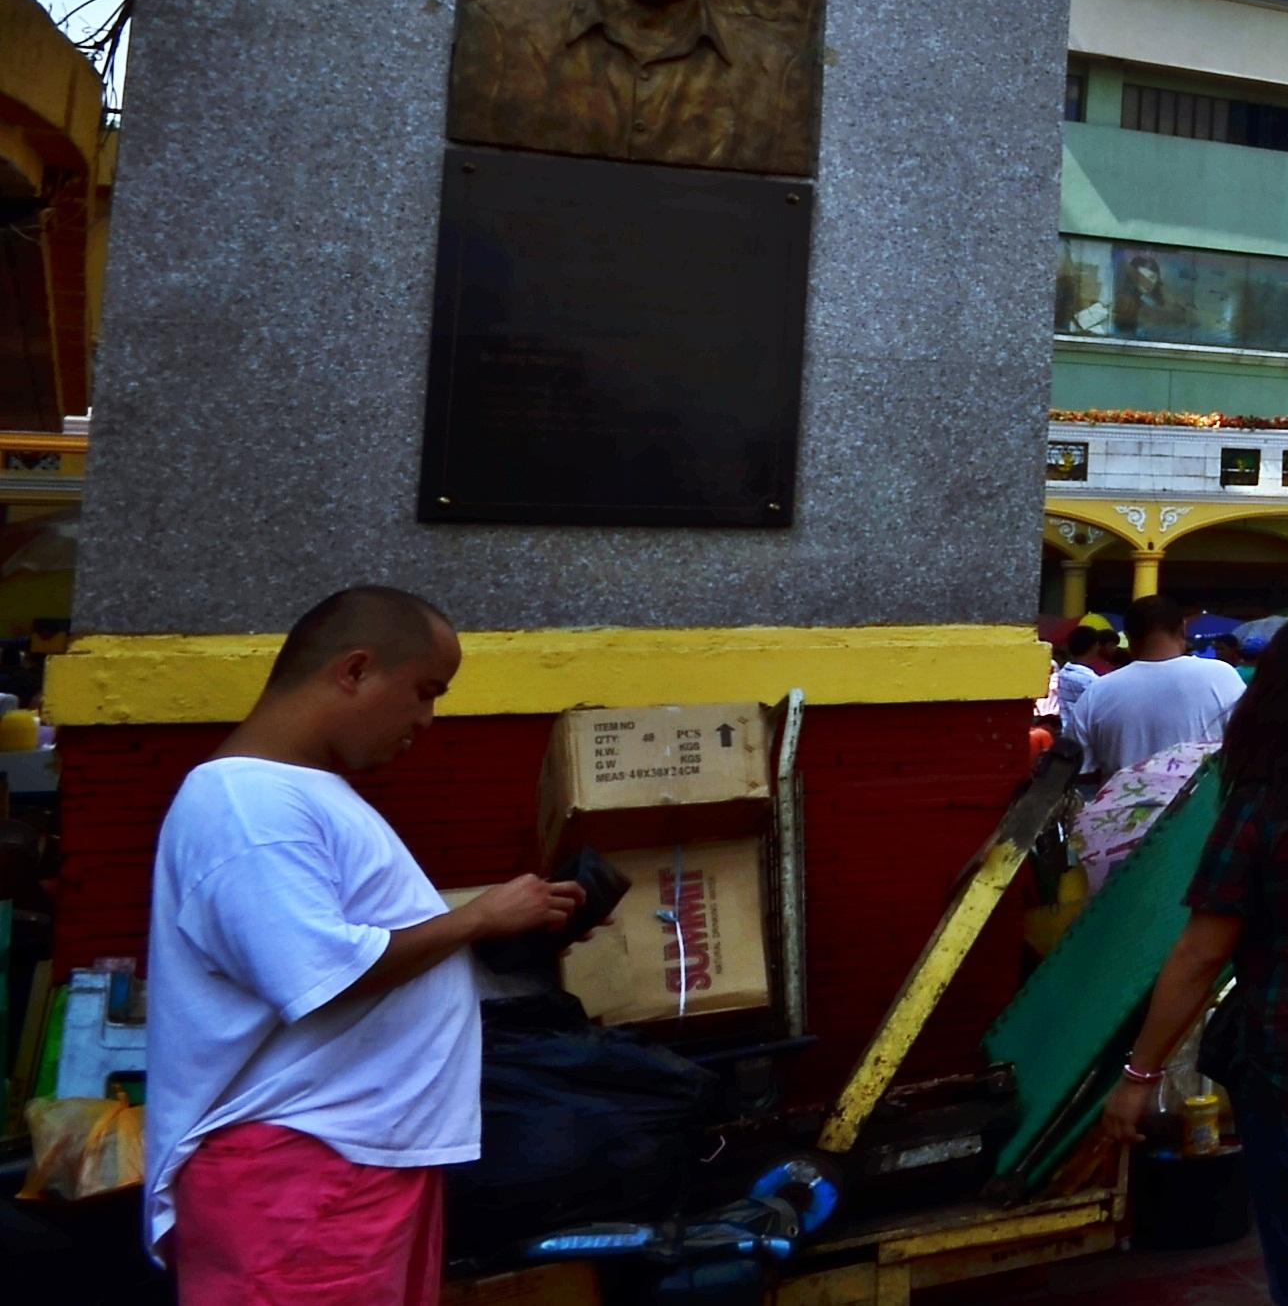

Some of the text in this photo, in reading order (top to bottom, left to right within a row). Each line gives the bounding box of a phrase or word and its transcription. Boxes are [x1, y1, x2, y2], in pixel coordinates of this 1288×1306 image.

[594, 722, 618, 732] ITEM
[677, 729, 702, 739] PCS
[679, 742, 700, 751] KGS
[680, 754, 702, 764] KGS
[658, 869, 713, 993] SUMMIT
